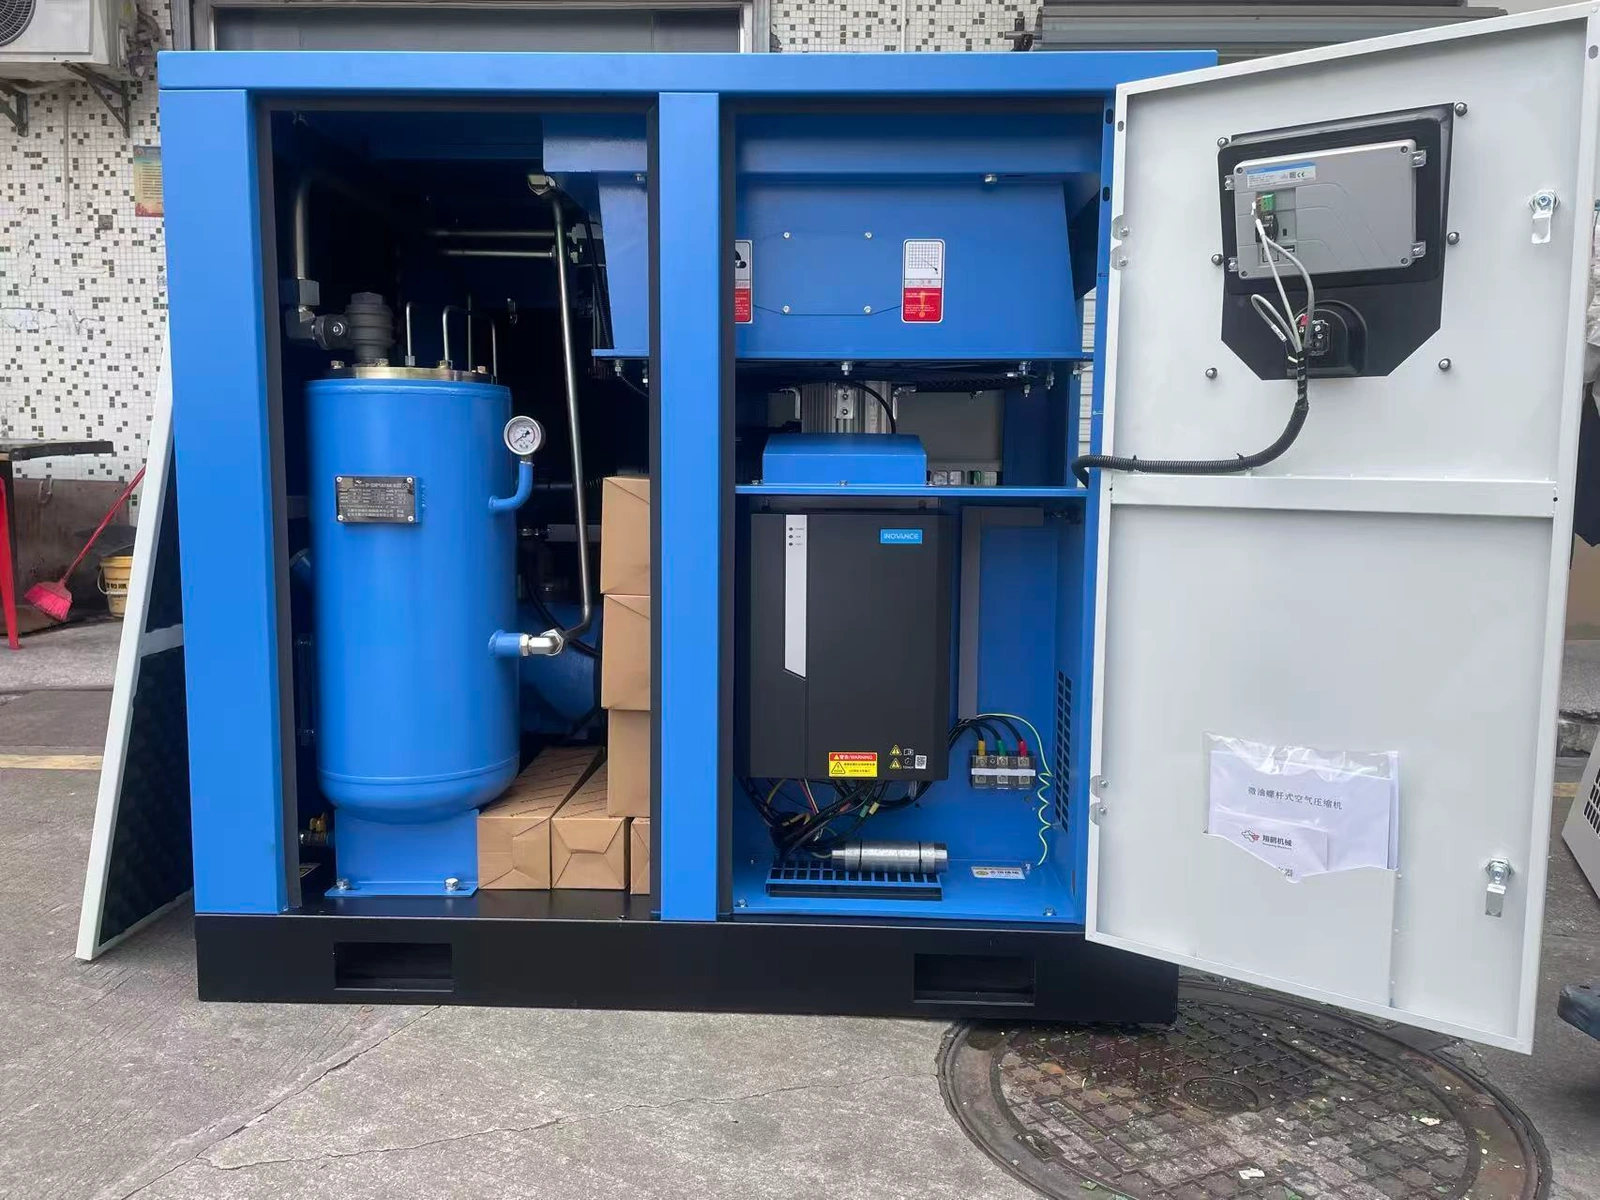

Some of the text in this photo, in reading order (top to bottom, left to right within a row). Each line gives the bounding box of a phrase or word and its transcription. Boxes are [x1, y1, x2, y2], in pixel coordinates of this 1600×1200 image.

[1248, 787, 1343, 810] 微油螺杆式空气压缩机
